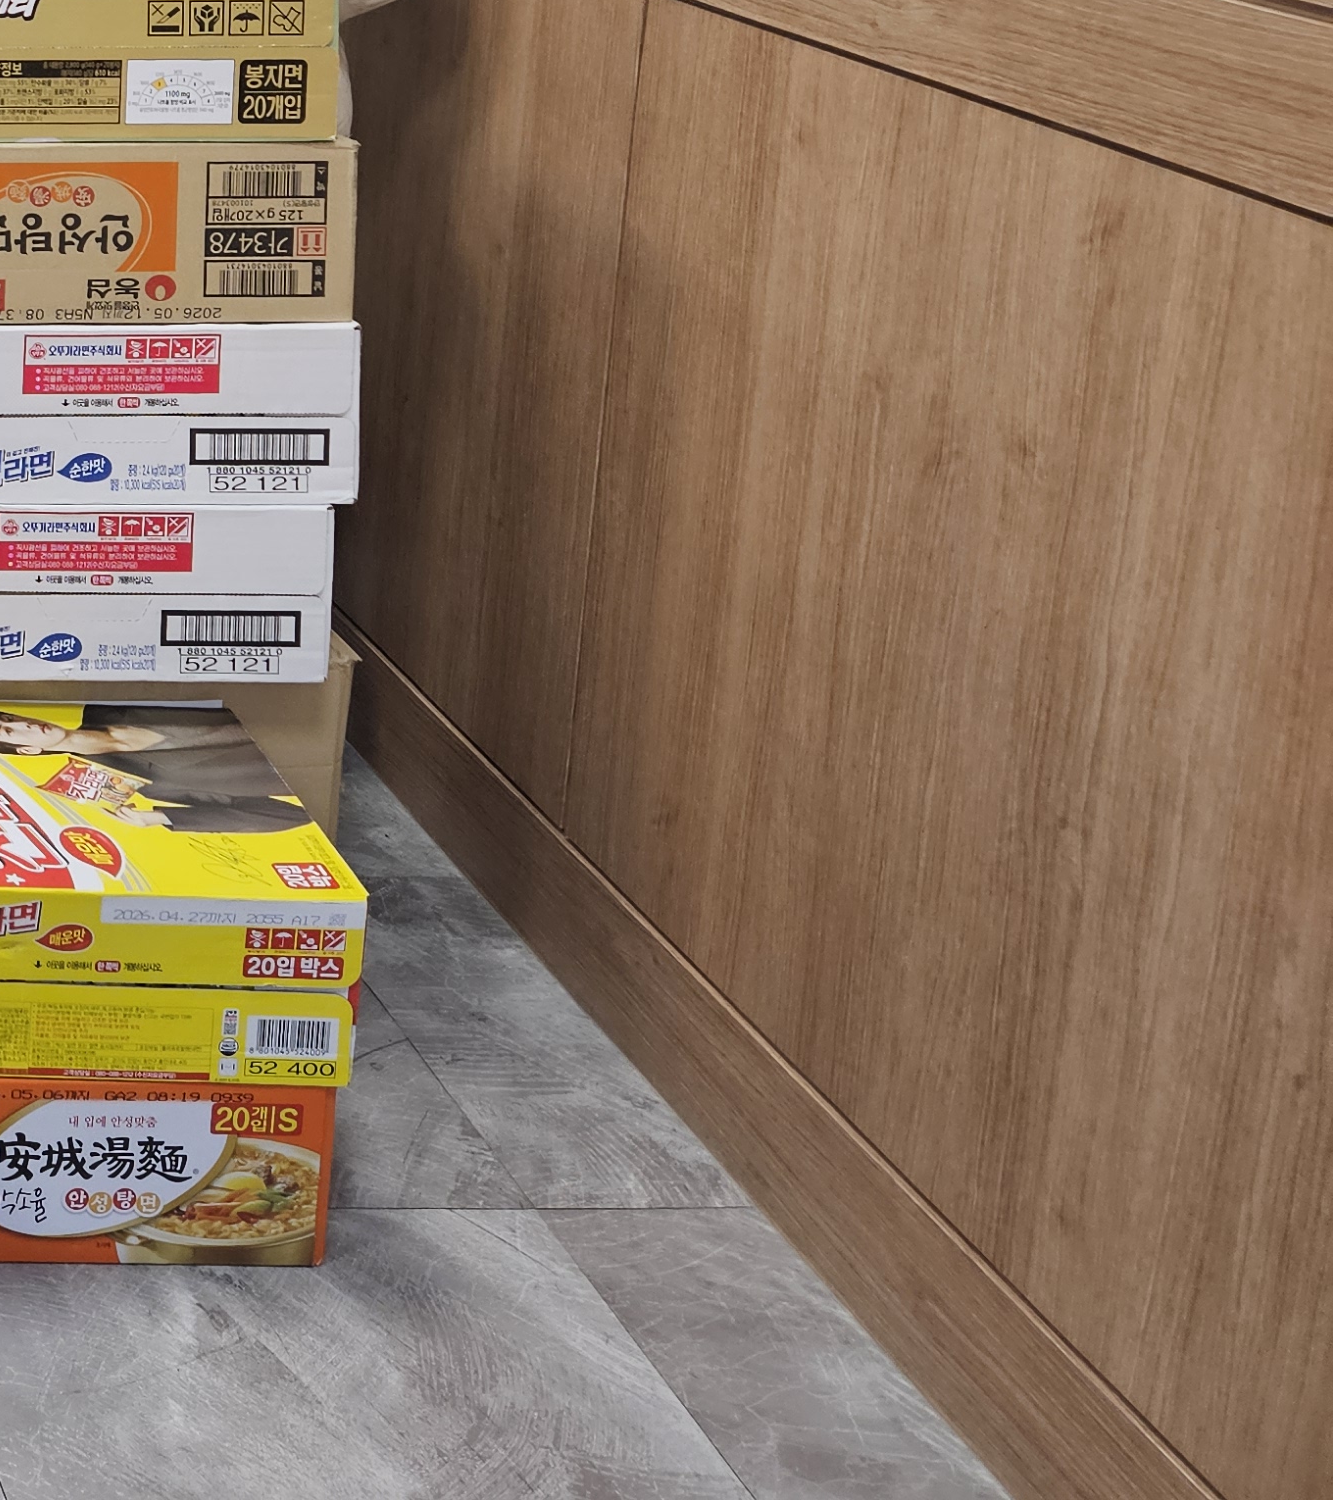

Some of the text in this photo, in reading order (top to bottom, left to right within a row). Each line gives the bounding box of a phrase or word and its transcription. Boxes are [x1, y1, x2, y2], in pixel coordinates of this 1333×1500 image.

[48, 929, 88, 947] 매운맛
[246, 956, 342, 980] 20입 박스
[248, 1060, 337, 1077] 52 400
